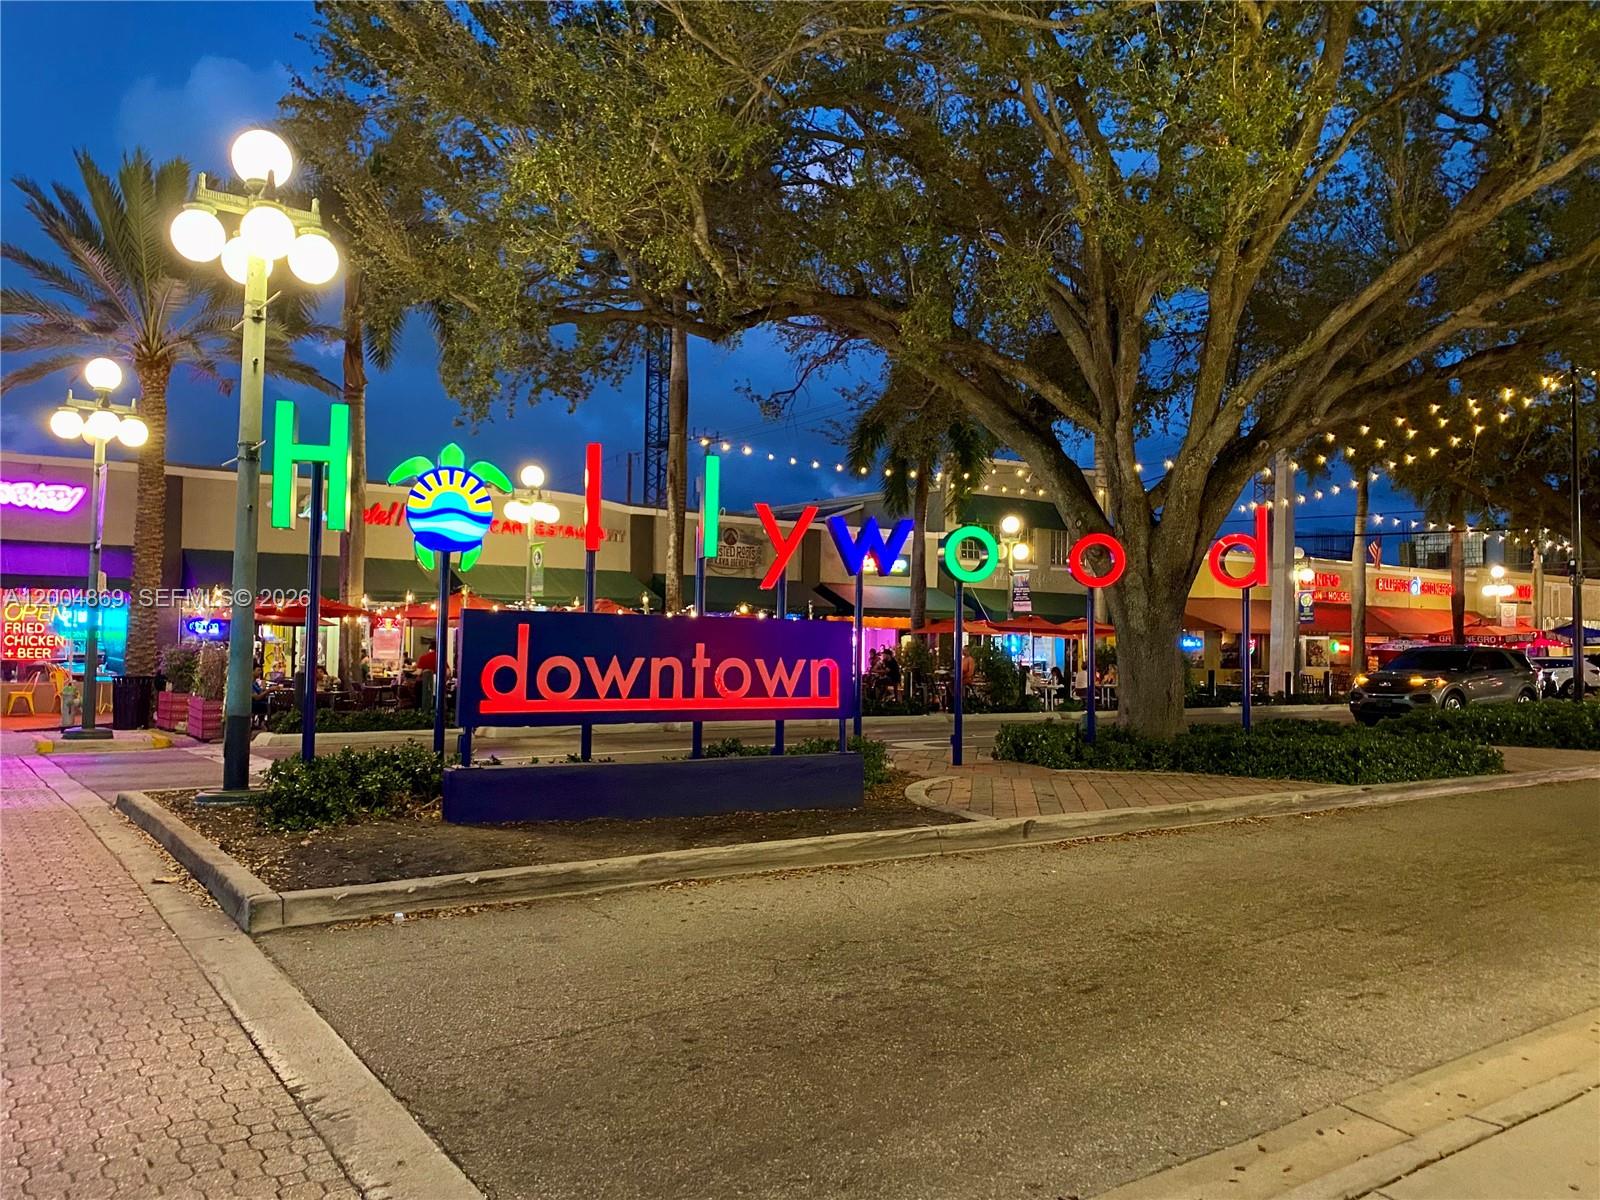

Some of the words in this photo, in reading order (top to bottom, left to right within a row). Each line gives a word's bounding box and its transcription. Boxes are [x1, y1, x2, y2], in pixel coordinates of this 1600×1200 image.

[4, 603, 64, 622] OPEN
[4, 622, 45, 634] FRIED
[4, 635, 65, 647] CHICKEN
[1465, 635, 1496, 643] NEGRO
[17, 647, 52, 659] BEER
[480, 623, 840, 711] downtown
